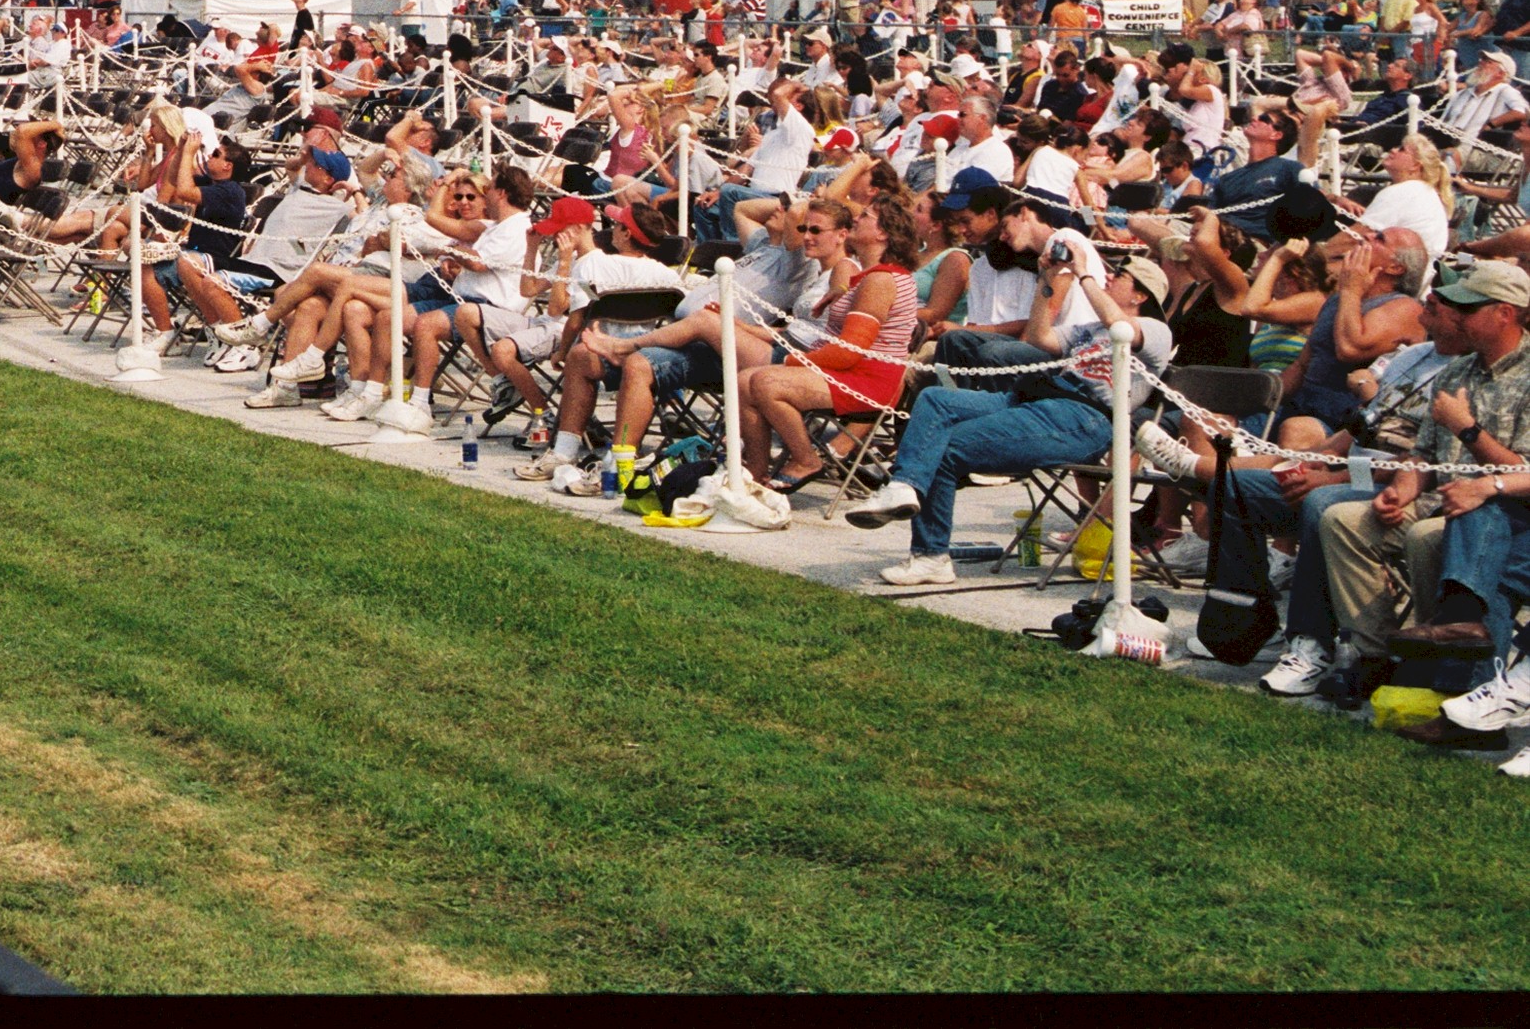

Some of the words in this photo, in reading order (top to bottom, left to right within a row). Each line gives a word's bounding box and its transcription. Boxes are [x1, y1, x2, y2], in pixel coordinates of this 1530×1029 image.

[1129, 3, 1160, 11] CHILD
[1108, 12, 1179, 21] CONVENIENCE
[1125, 23, 1165, 31] CENTER
